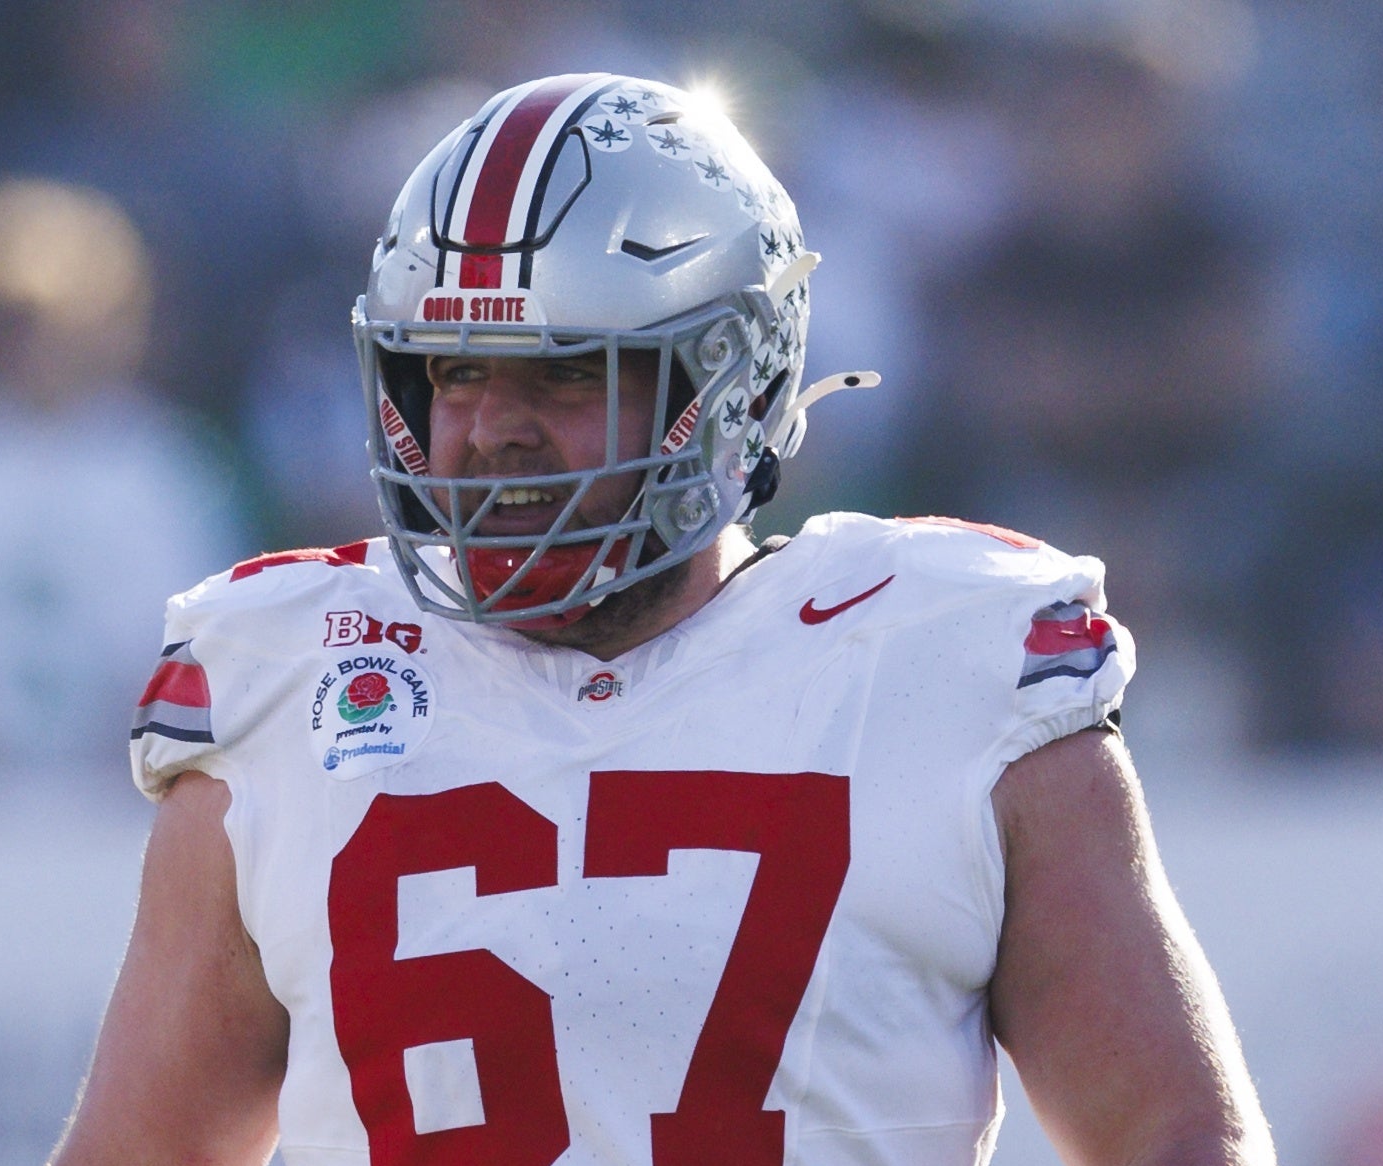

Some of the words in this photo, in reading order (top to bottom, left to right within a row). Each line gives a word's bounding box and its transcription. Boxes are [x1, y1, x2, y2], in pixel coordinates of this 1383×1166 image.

[423, 297, 464, 322] OHIO
[470, 297, 525, 322] STATE
[312, 672, 337, 731] ROSE
[337, 656, 397, 675] BOWL
[400, 668, 429, 718] GAME
